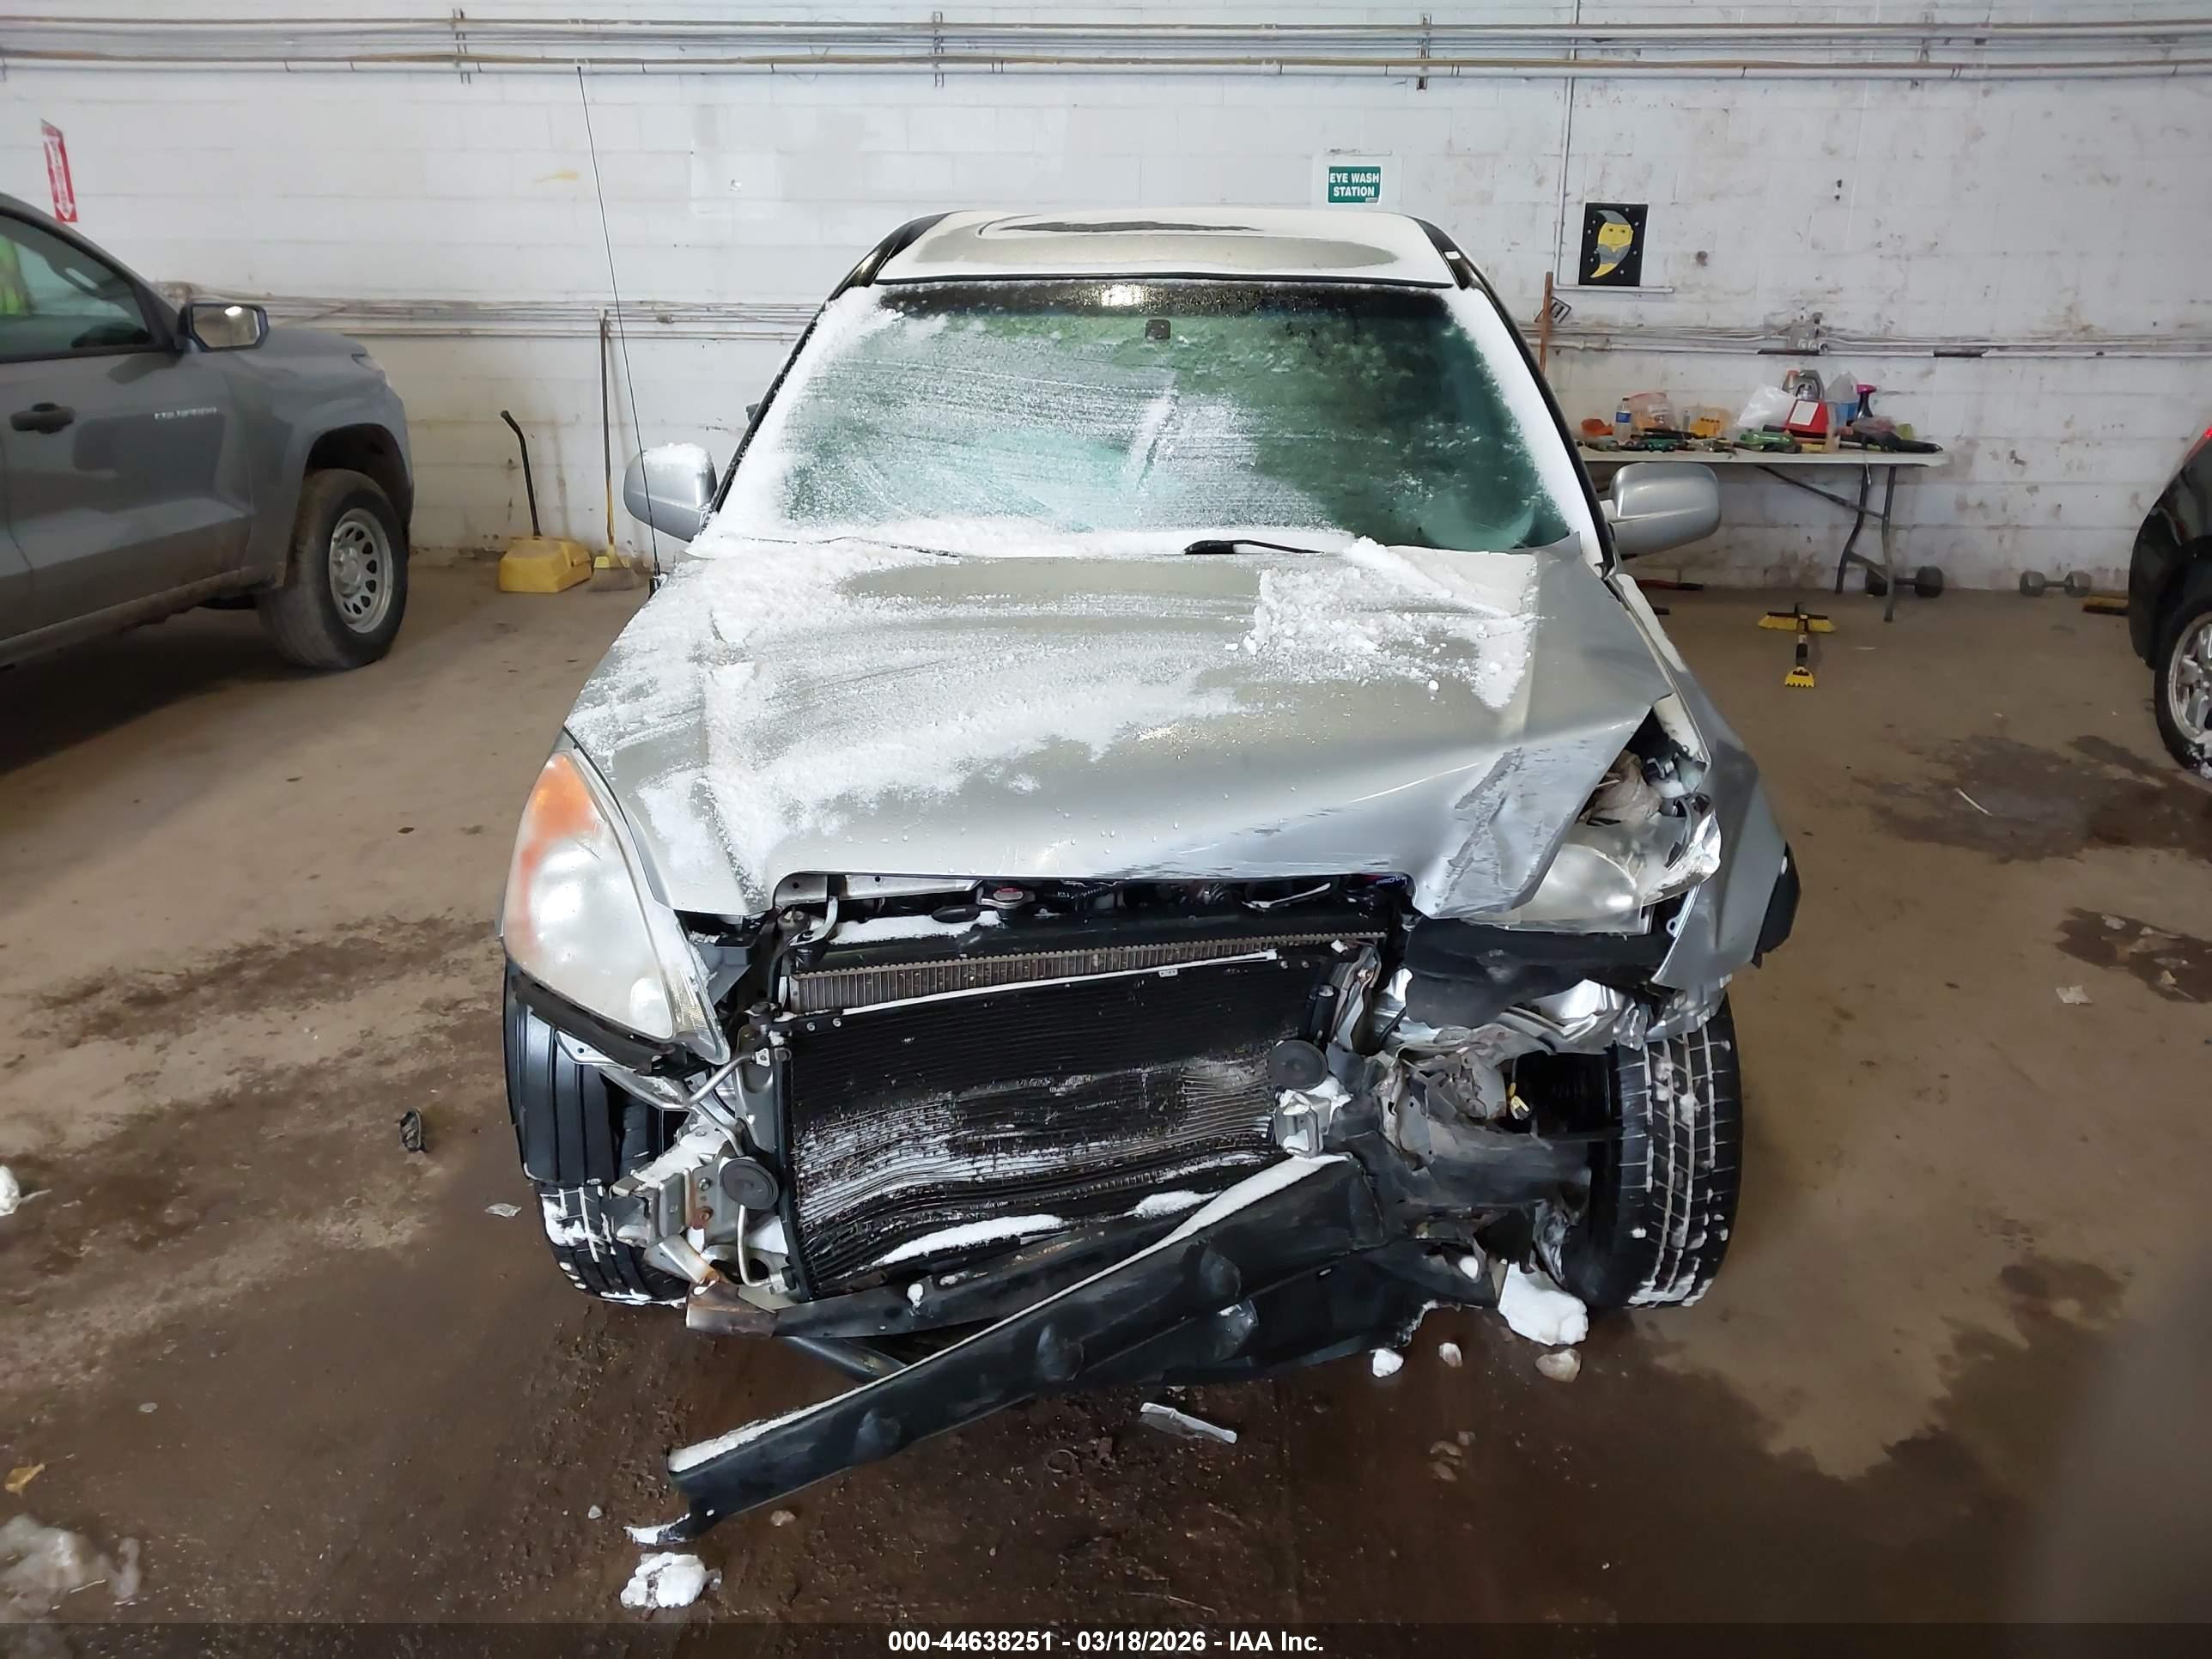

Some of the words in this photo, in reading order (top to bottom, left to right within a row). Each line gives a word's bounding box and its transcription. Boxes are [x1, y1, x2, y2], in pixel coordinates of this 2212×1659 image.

[1329, 172, 1349, 184] EYE
[1351, 172, 1380, 184] WASH
[1333, 185, 1375, 198] STATION
